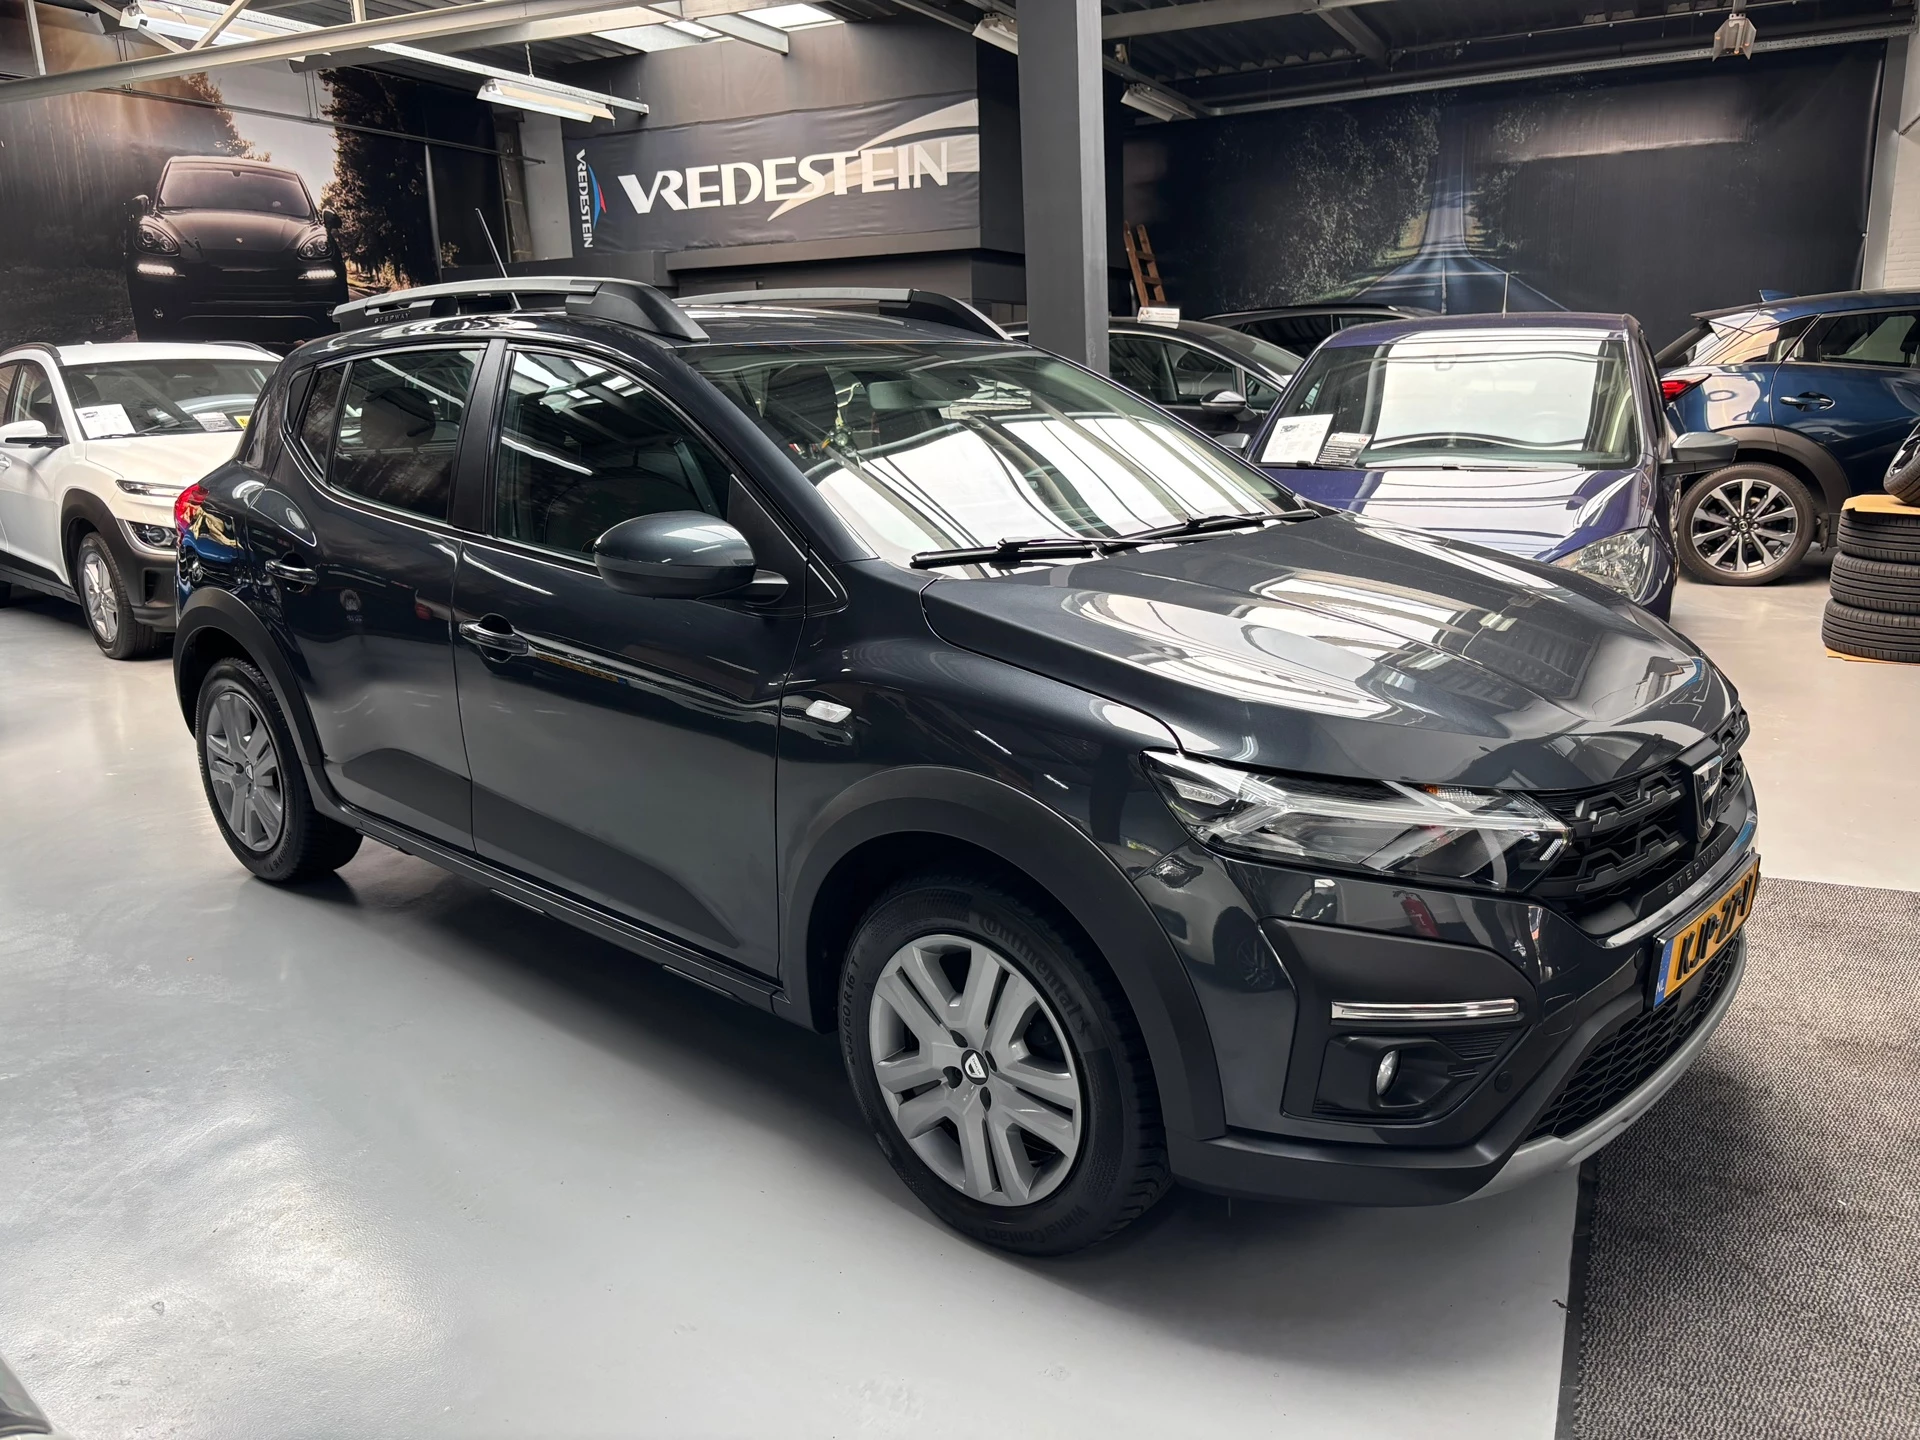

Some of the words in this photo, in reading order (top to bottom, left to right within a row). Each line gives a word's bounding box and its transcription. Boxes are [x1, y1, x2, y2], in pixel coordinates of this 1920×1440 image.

[576, 148, 594, 249] VREDESTEIN
[617, 141, 948, 215] VREDESTEIN
[374, 312, 410, 324] STEPWAY
[1666, 841, 1723, 895] STEPWAY
[1656, 981, 1665, 996] NL
